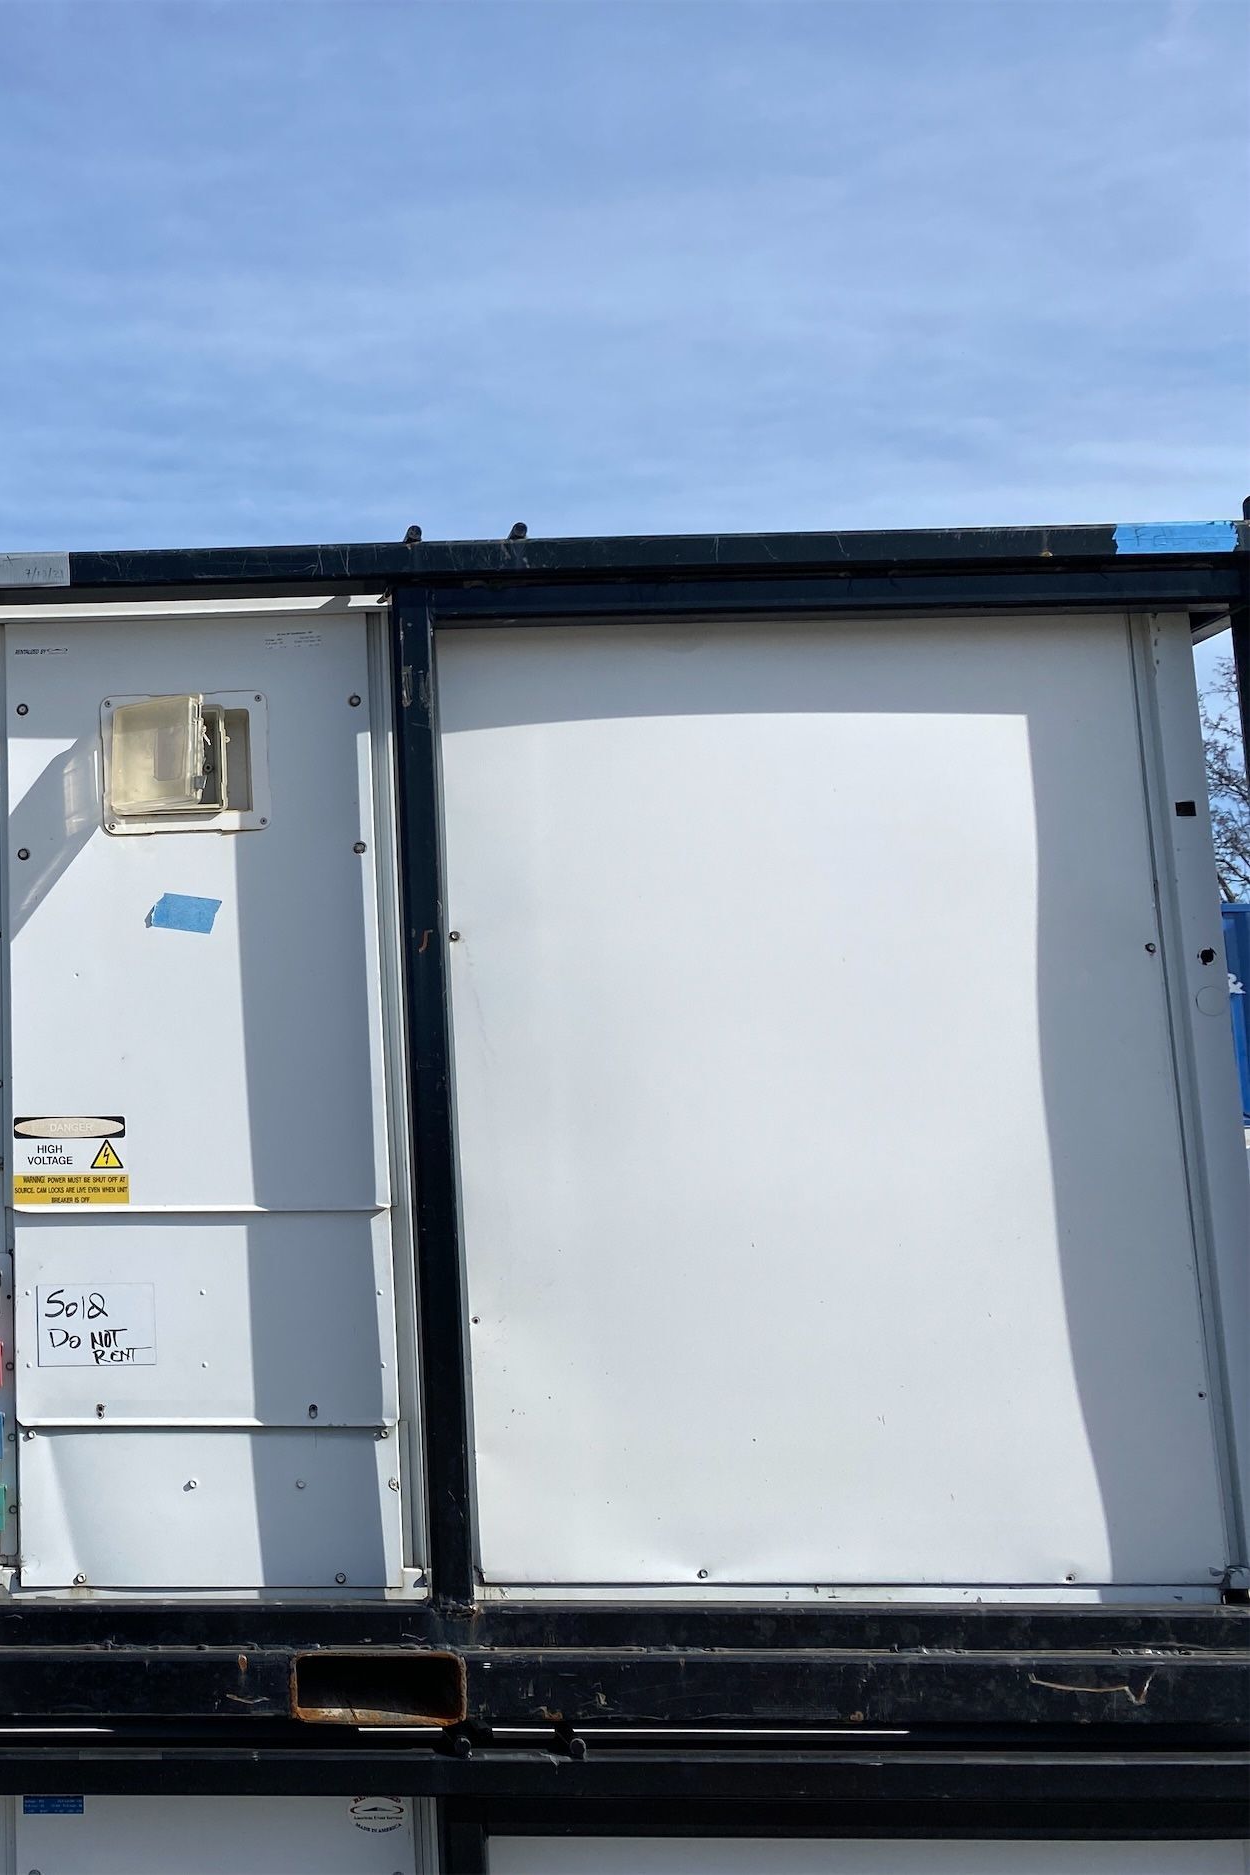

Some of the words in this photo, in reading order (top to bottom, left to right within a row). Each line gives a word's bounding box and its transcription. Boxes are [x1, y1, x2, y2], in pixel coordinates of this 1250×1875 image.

[49, 1123, 94, 1132] DANGER
[37, 1144, 63, 1154] HIGH
[27, 1155, 74, 1165] VOLTAGE
[47, 1176, 66, 1184] POWER
[44, 1289, 109, 1320] Sold
[47, 1328, 82, 1349] Do
[90, 1328, 128, 1350] NOT
[92, 1346, 152, 1365] RENT
